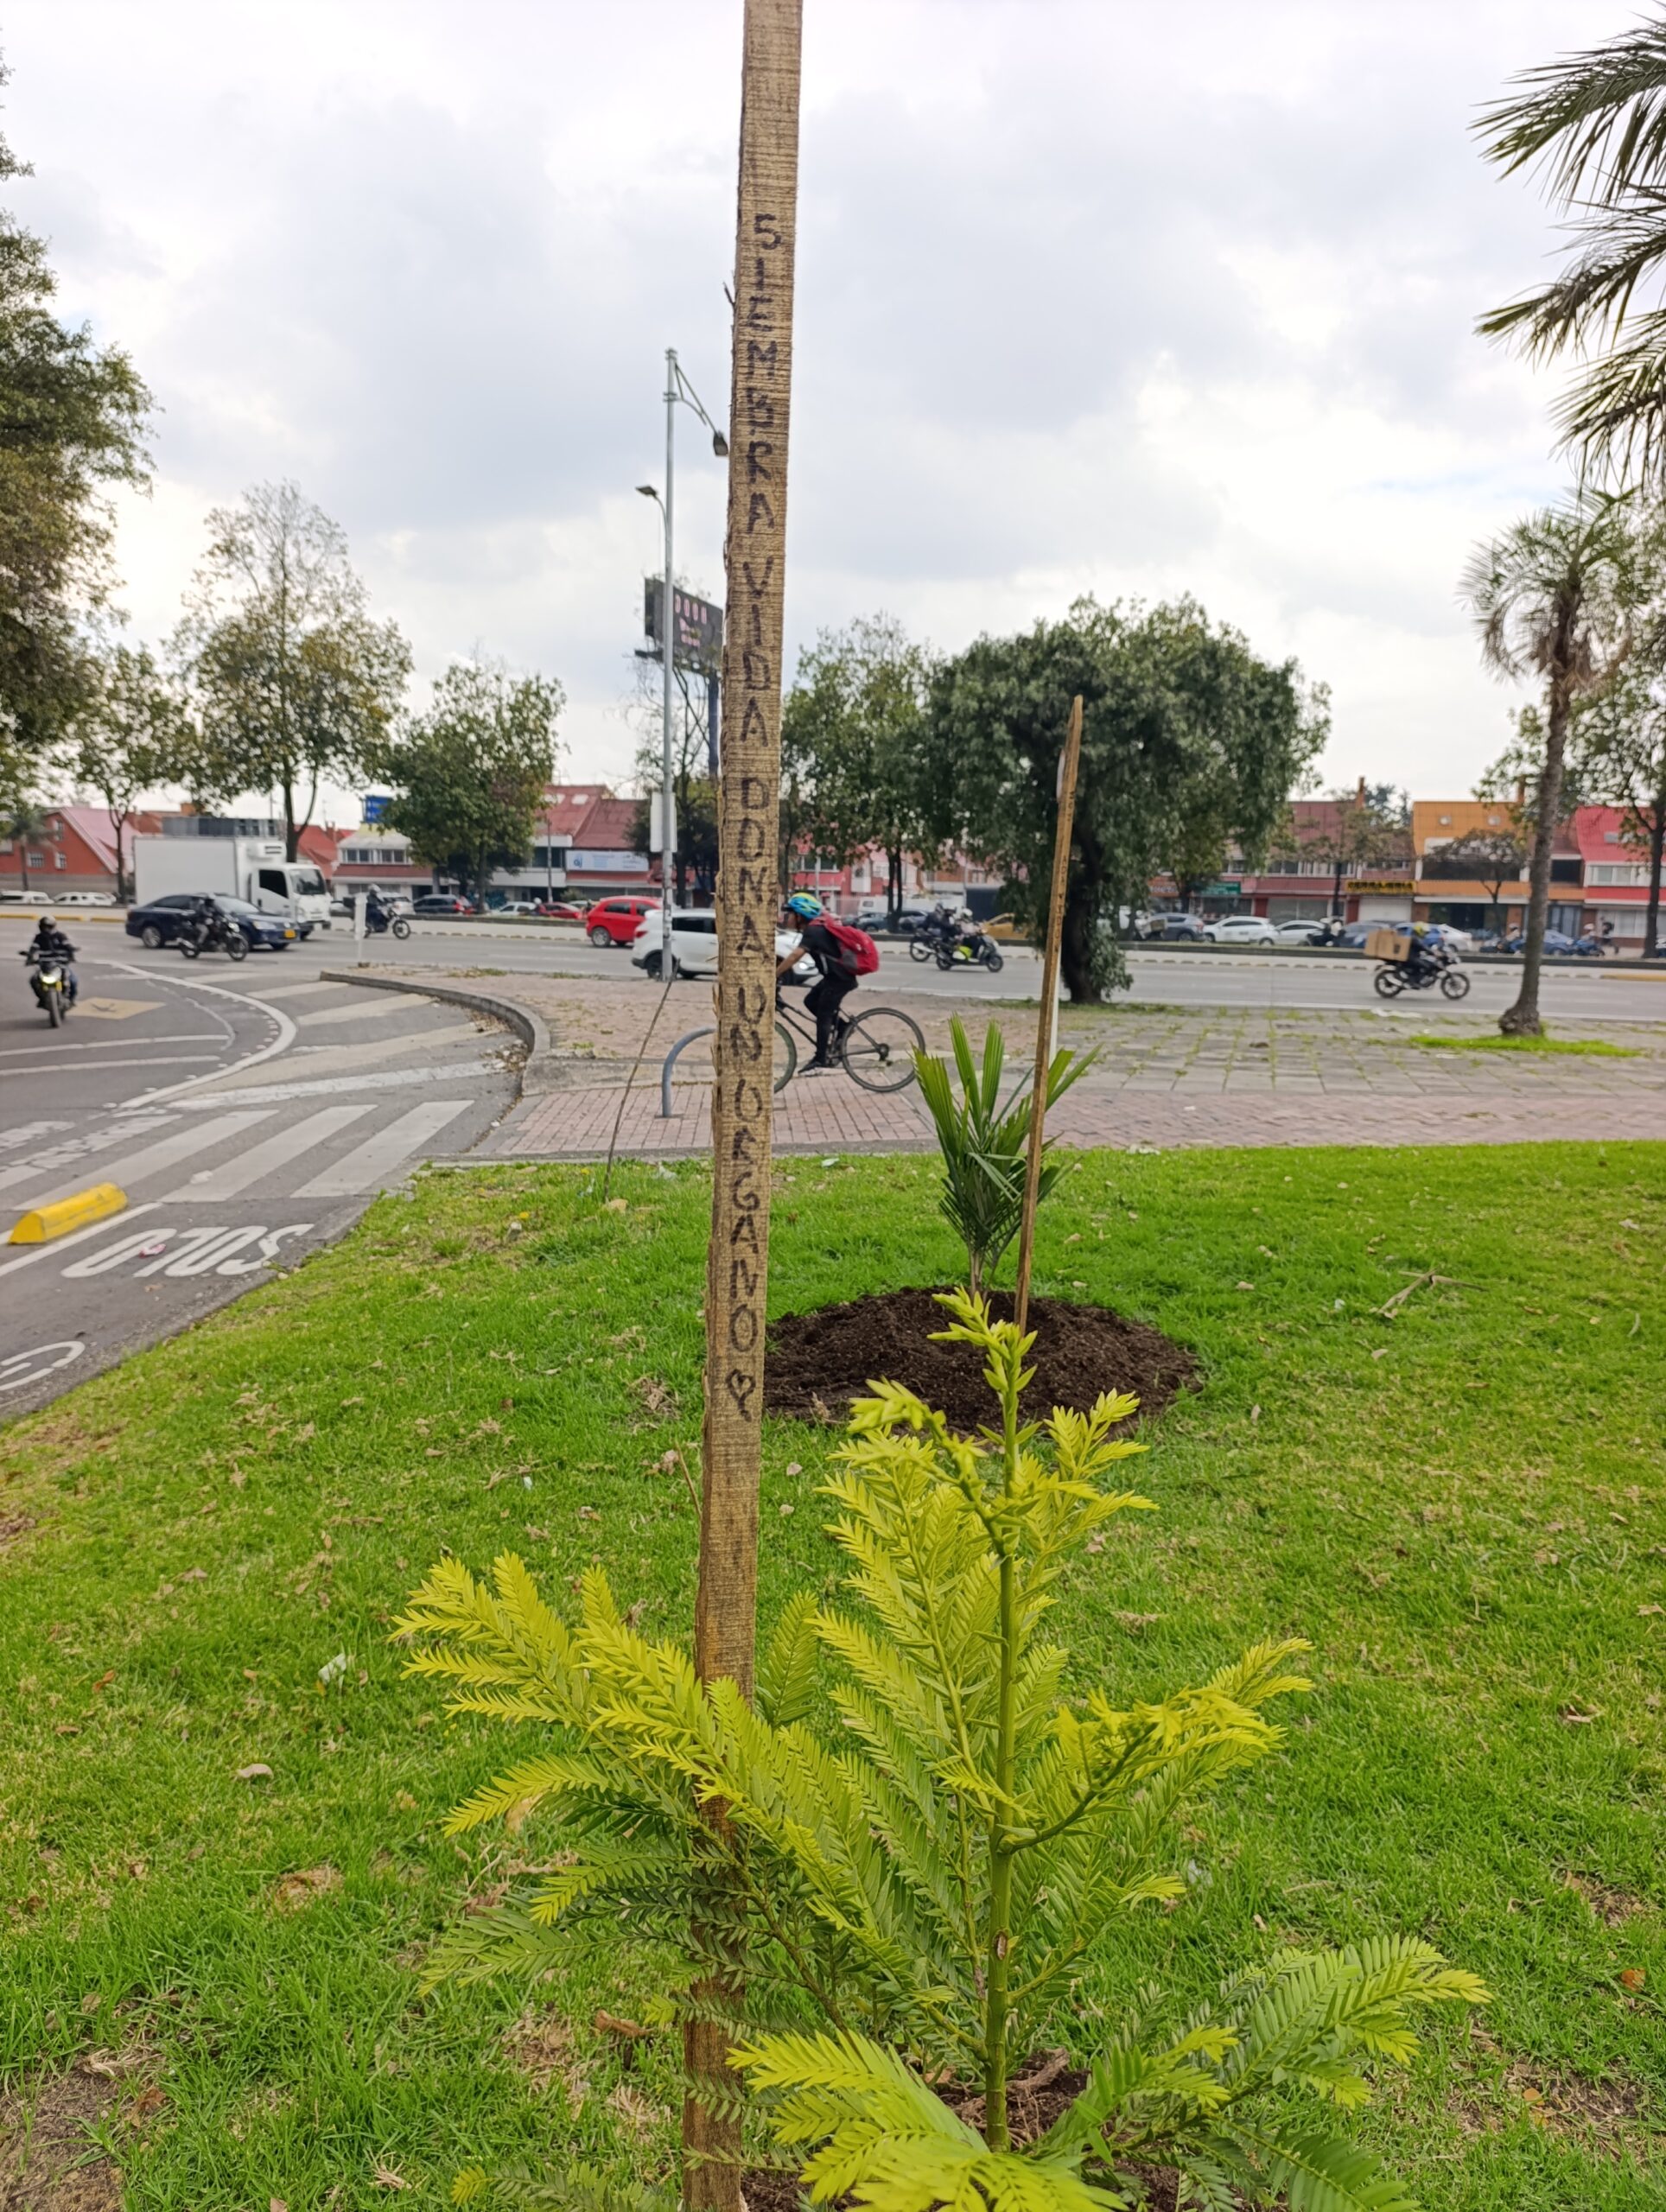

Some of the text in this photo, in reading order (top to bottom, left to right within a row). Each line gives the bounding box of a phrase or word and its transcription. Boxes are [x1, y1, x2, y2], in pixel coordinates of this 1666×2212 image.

[729, 213, 782, 1354] SIEMBRA VIDA DONA UN ORGANO
[60, 1224, 315, 1278] SOLO
